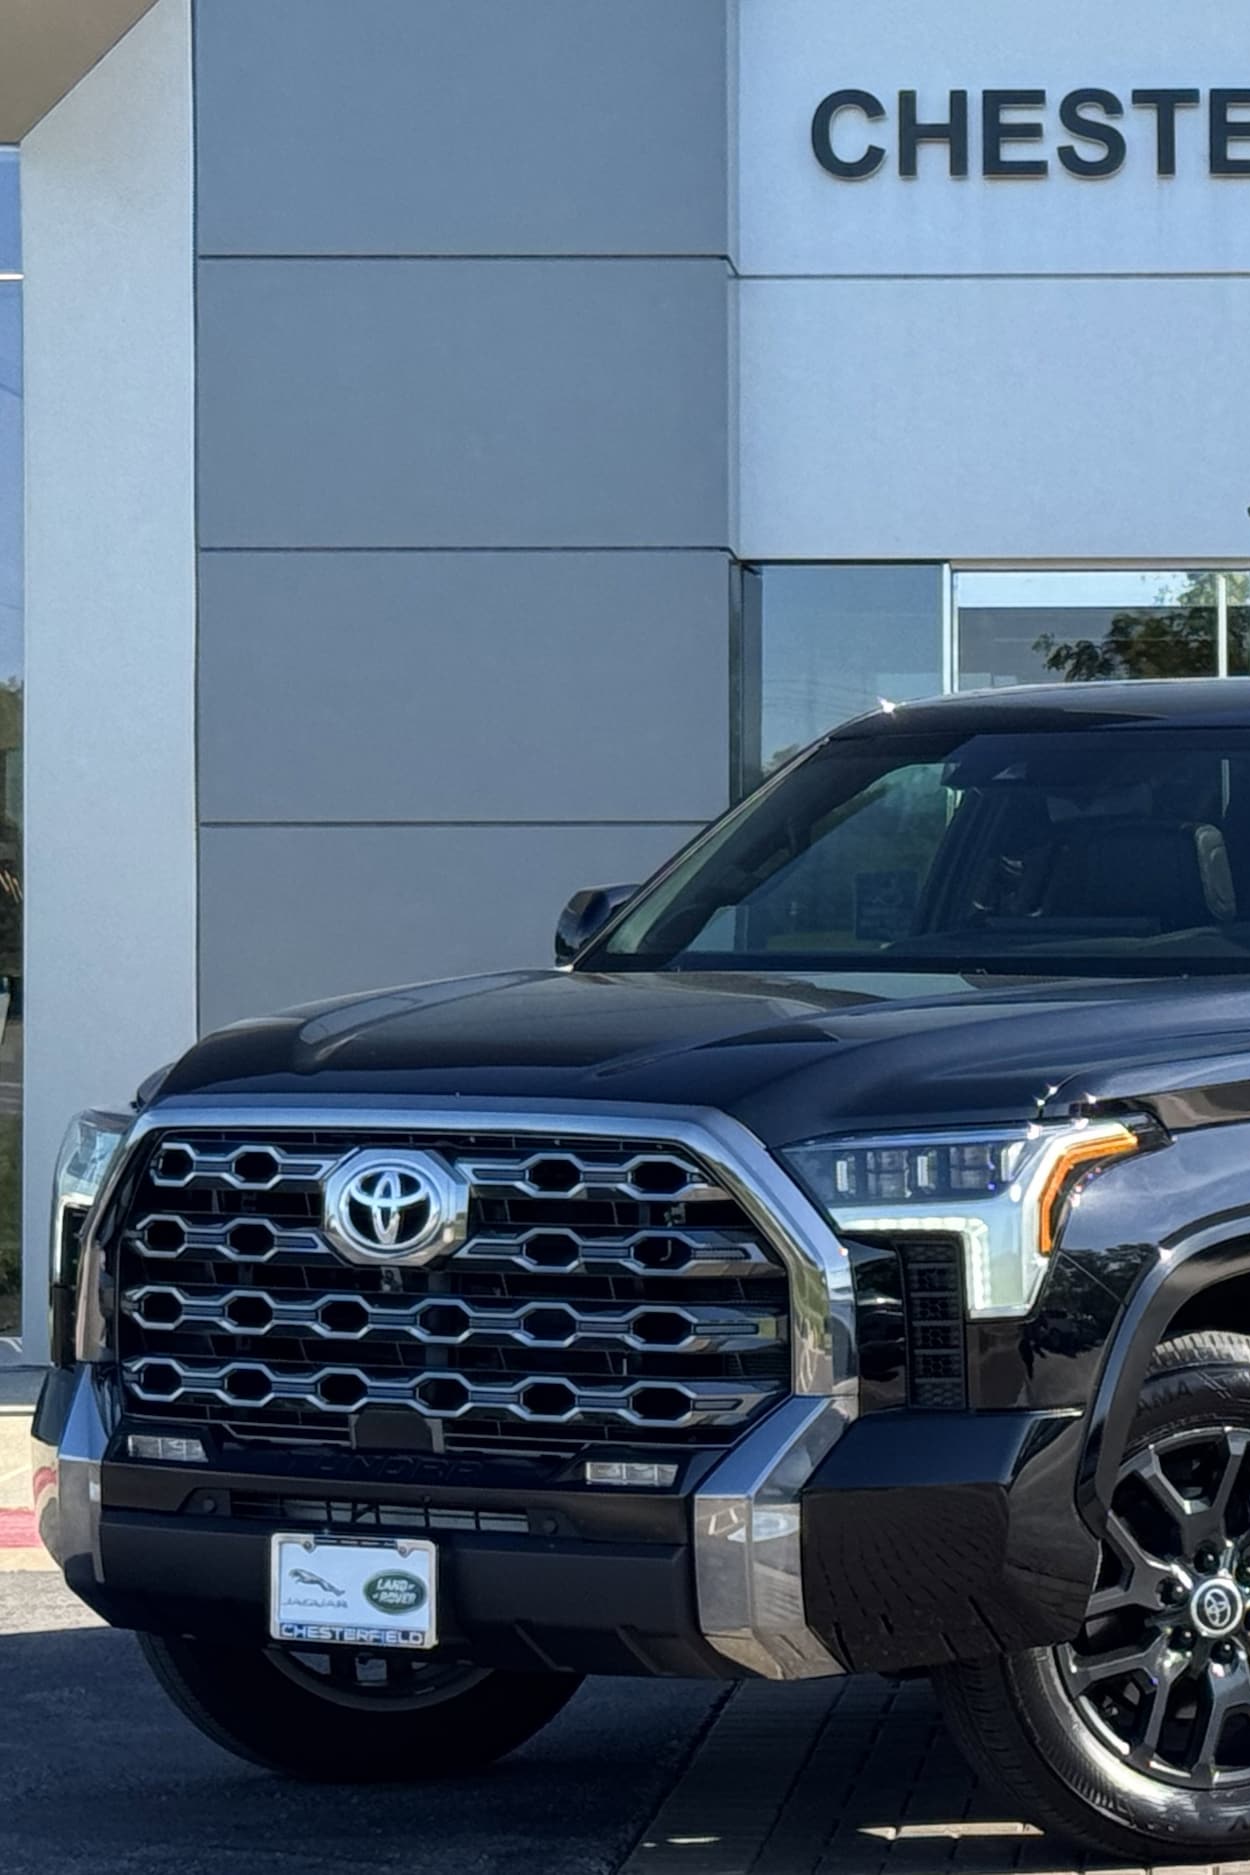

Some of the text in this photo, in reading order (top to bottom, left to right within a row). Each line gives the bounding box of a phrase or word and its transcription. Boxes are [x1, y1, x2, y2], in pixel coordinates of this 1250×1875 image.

[375, 1578, 408, 1591] LAND
[282, 1597, 349, 1609] JAGUAR
[280, 1623, 425, 1645] CHESTERFIELD
